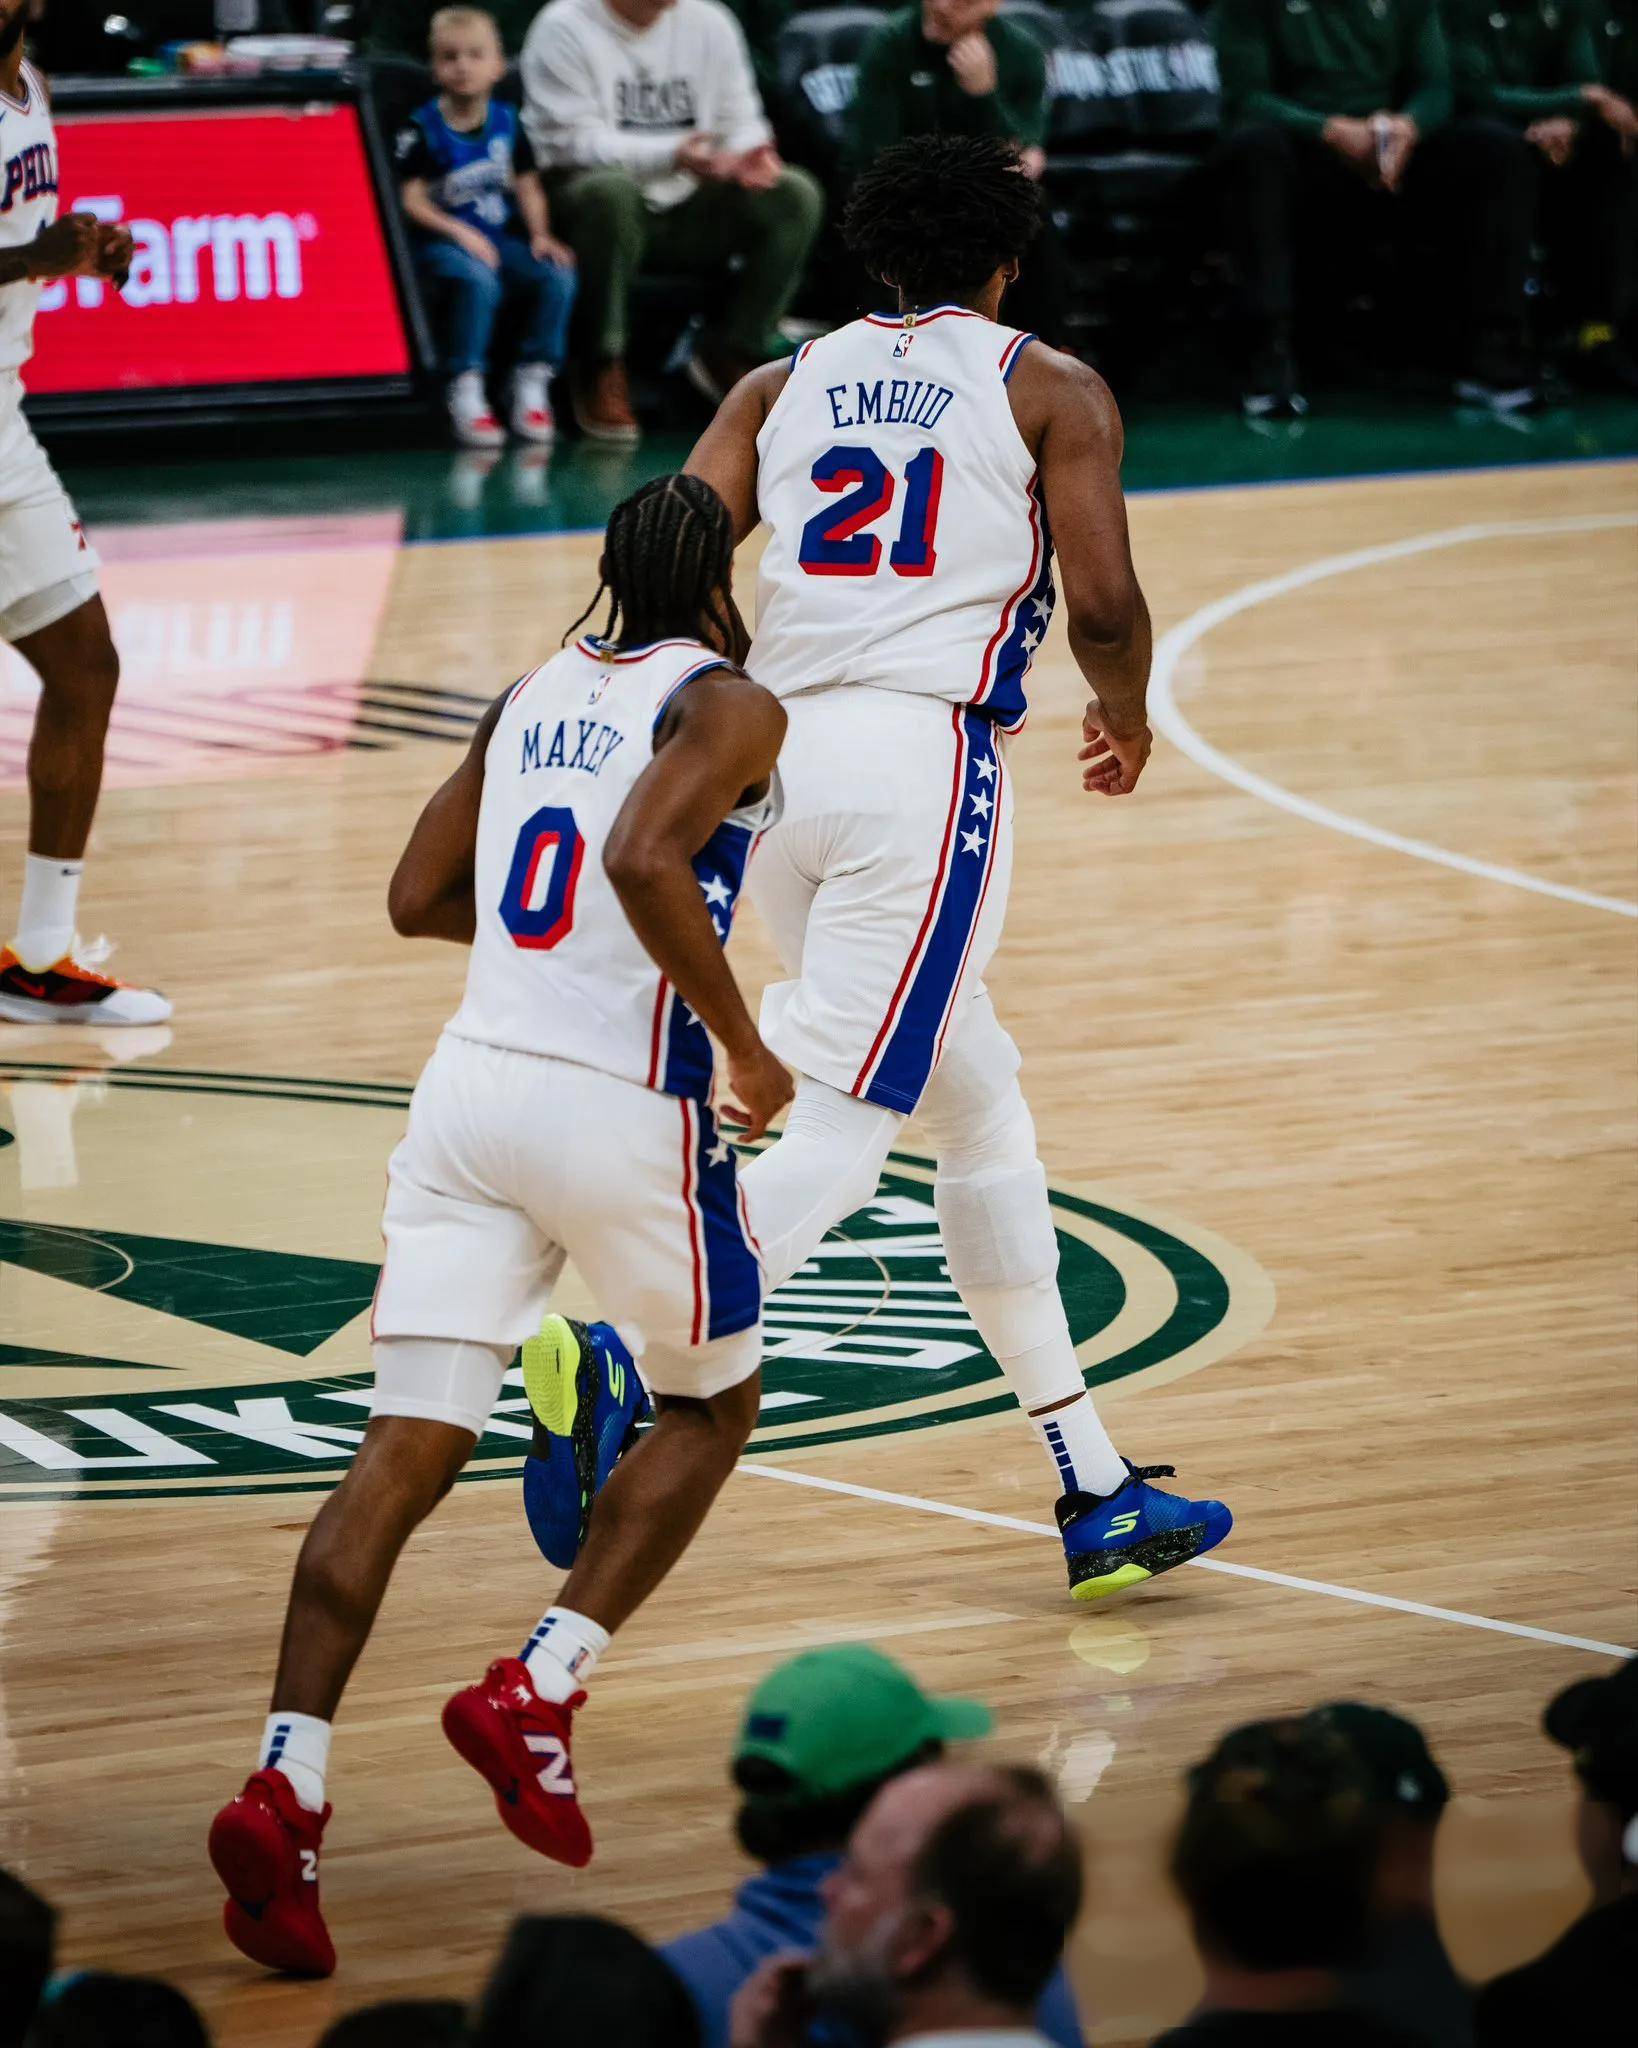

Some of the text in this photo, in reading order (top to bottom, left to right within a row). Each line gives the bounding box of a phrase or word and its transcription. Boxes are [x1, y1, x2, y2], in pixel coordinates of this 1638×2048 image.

[826, 379, 954, 430] EMBIID
[798, 445, 945, 577] 21
[520, 719, 624, 777] MAXEY
[497, 805, 586, 952] 0
